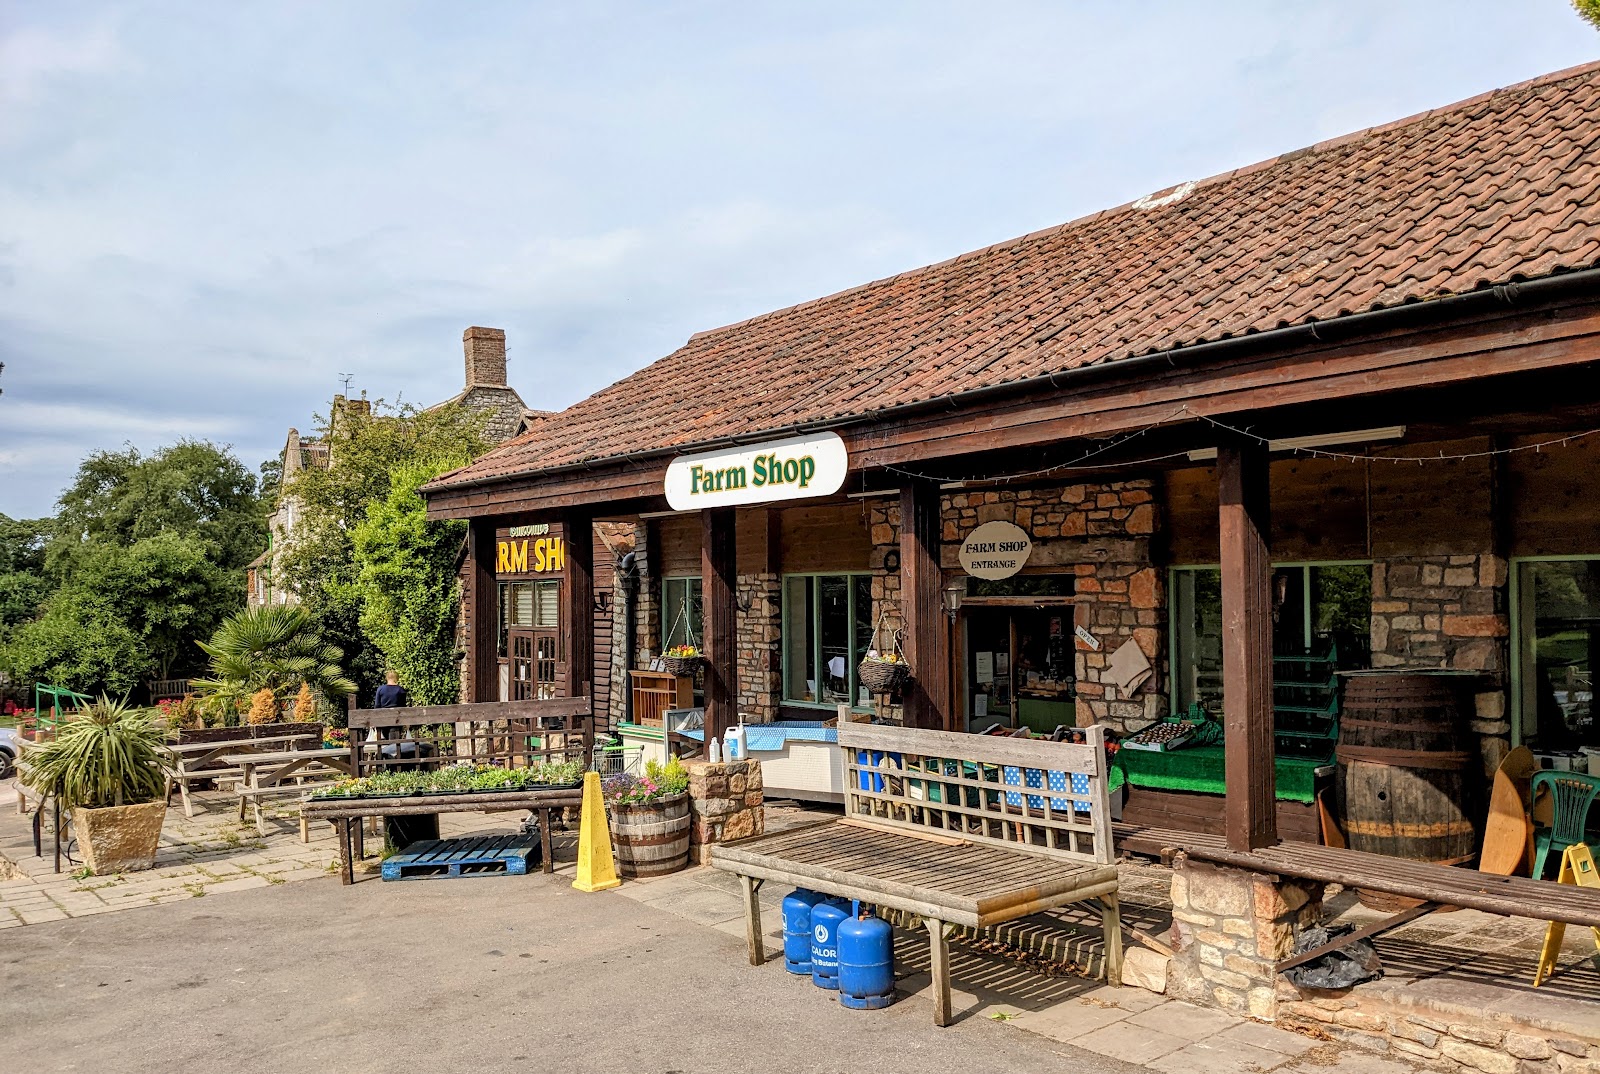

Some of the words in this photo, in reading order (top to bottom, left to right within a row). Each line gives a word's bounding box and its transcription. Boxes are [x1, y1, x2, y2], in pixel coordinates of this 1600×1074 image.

[690, 464, 747, 496] Farm
[752, 452, 816, 489] Shop
[965, 542, 996, 554] FARM
[999, 541, 1028, 552] SHOP
[496, 539, 529, 573] RM
[1079, 630, 1095, 646] OPEN
[811, 945, 837, 958] CALOR
